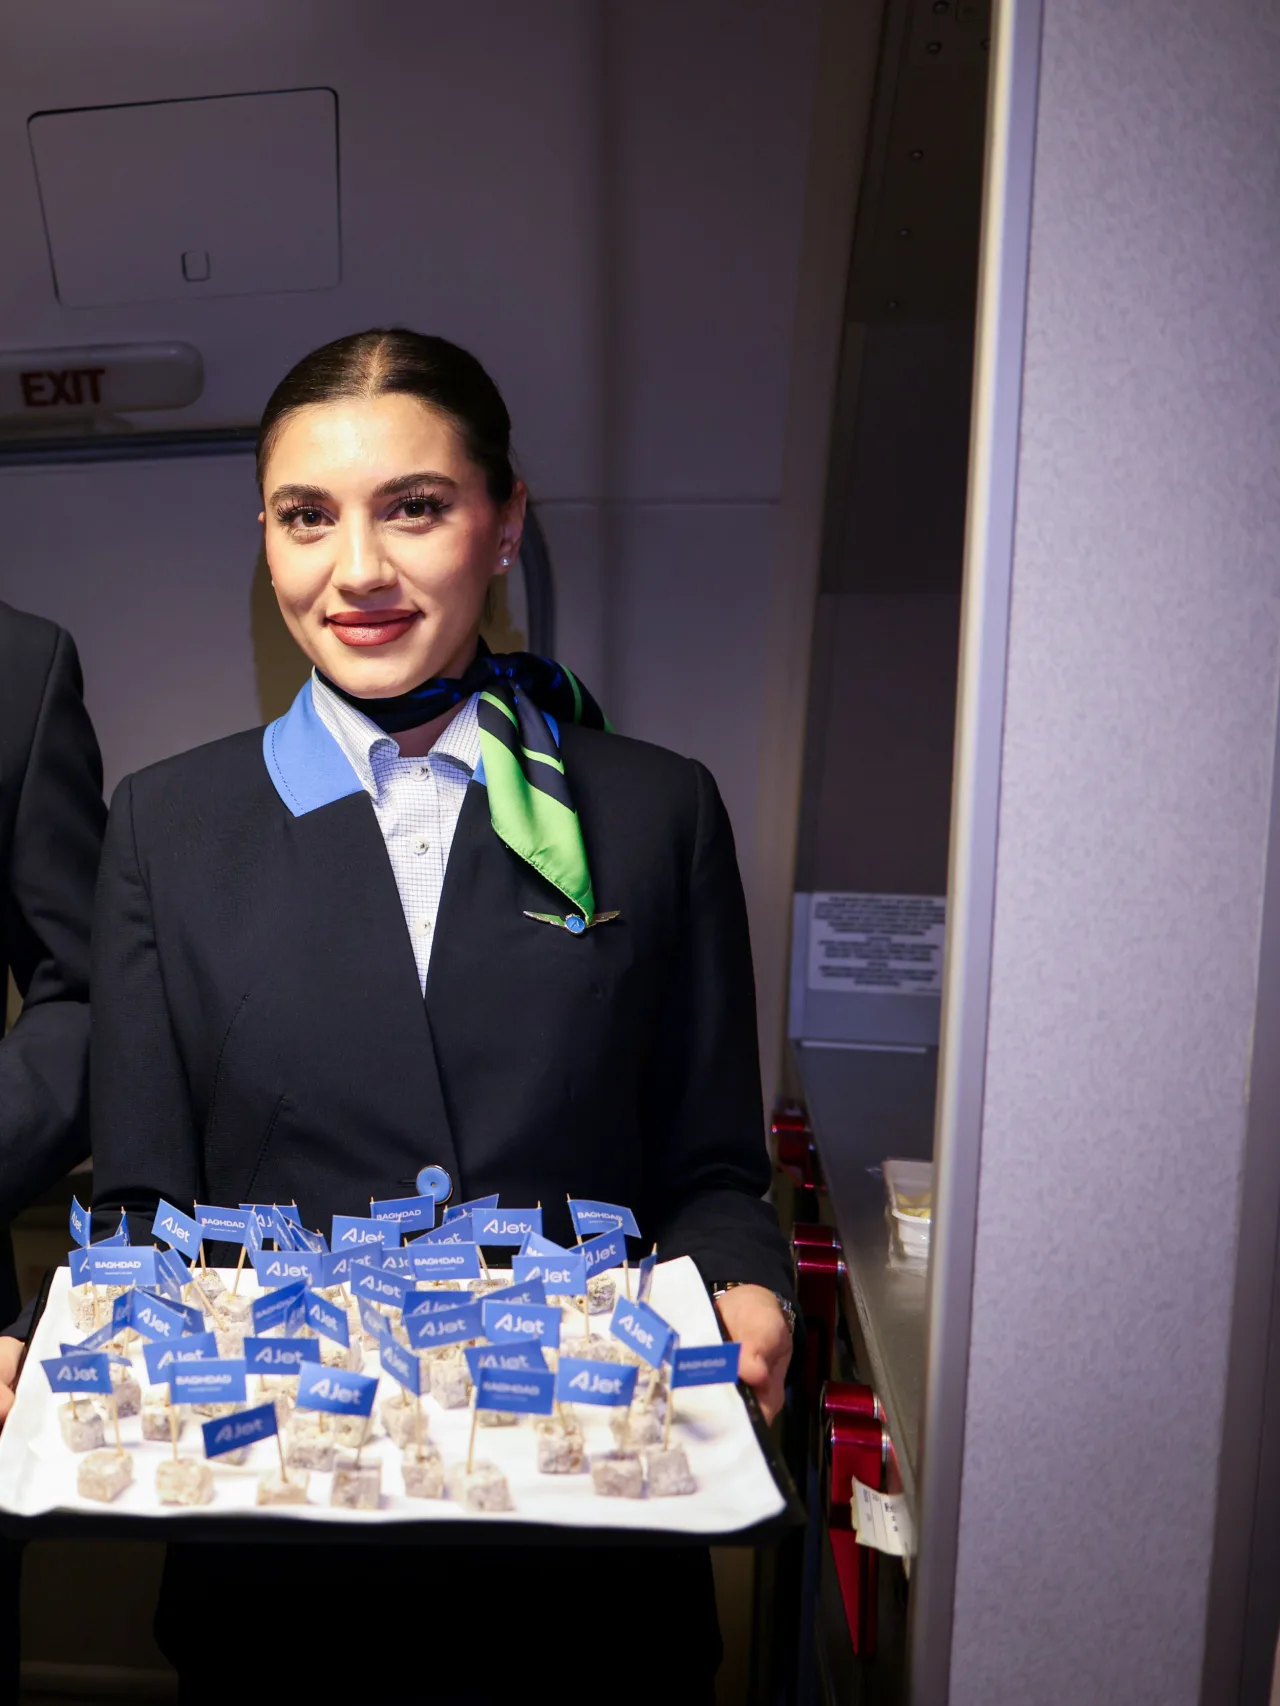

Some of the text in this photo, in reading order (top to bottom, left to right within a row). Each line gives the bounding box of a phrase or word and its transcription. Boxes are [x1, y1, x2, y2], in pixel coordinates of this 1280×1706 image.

[20, 366, 105, 407] EXIT
[201, 1217, 246, 1229] BAGHDAD
[377, 1209, 421, 1220] BAGHDAD
[161, 1216, 191, 1243] AJet
[342, 1227, 385, 1244] AJet
[483, 1219, 527, 1234] AJet
[95, 1261, 141, 1269] BAGHDAD
[266, 1261, 309, 1277] AJet
[414, 1256, 465, 1266] BAGHDAD
[525, 1266, 571, 1283] AJet
[359, 1275, 401, 1299] AJet
[137, 1307, 171, 1338] AJet
[310, 1304, 338, 1332] AJet
[495, 1312, 544, 1334] AJet
[419, 1319, 467, 1337] AJet
[619, 1313, 655, 1349] AJet
[255, 1347, 304, 1364] AJet
[57, 1365, 99, 1381] AJet
[570, 1370, 623, 1394] AJet
[310, 1378, 361, 1404] AJet
[215, 1418, 264, 1443] AJet
